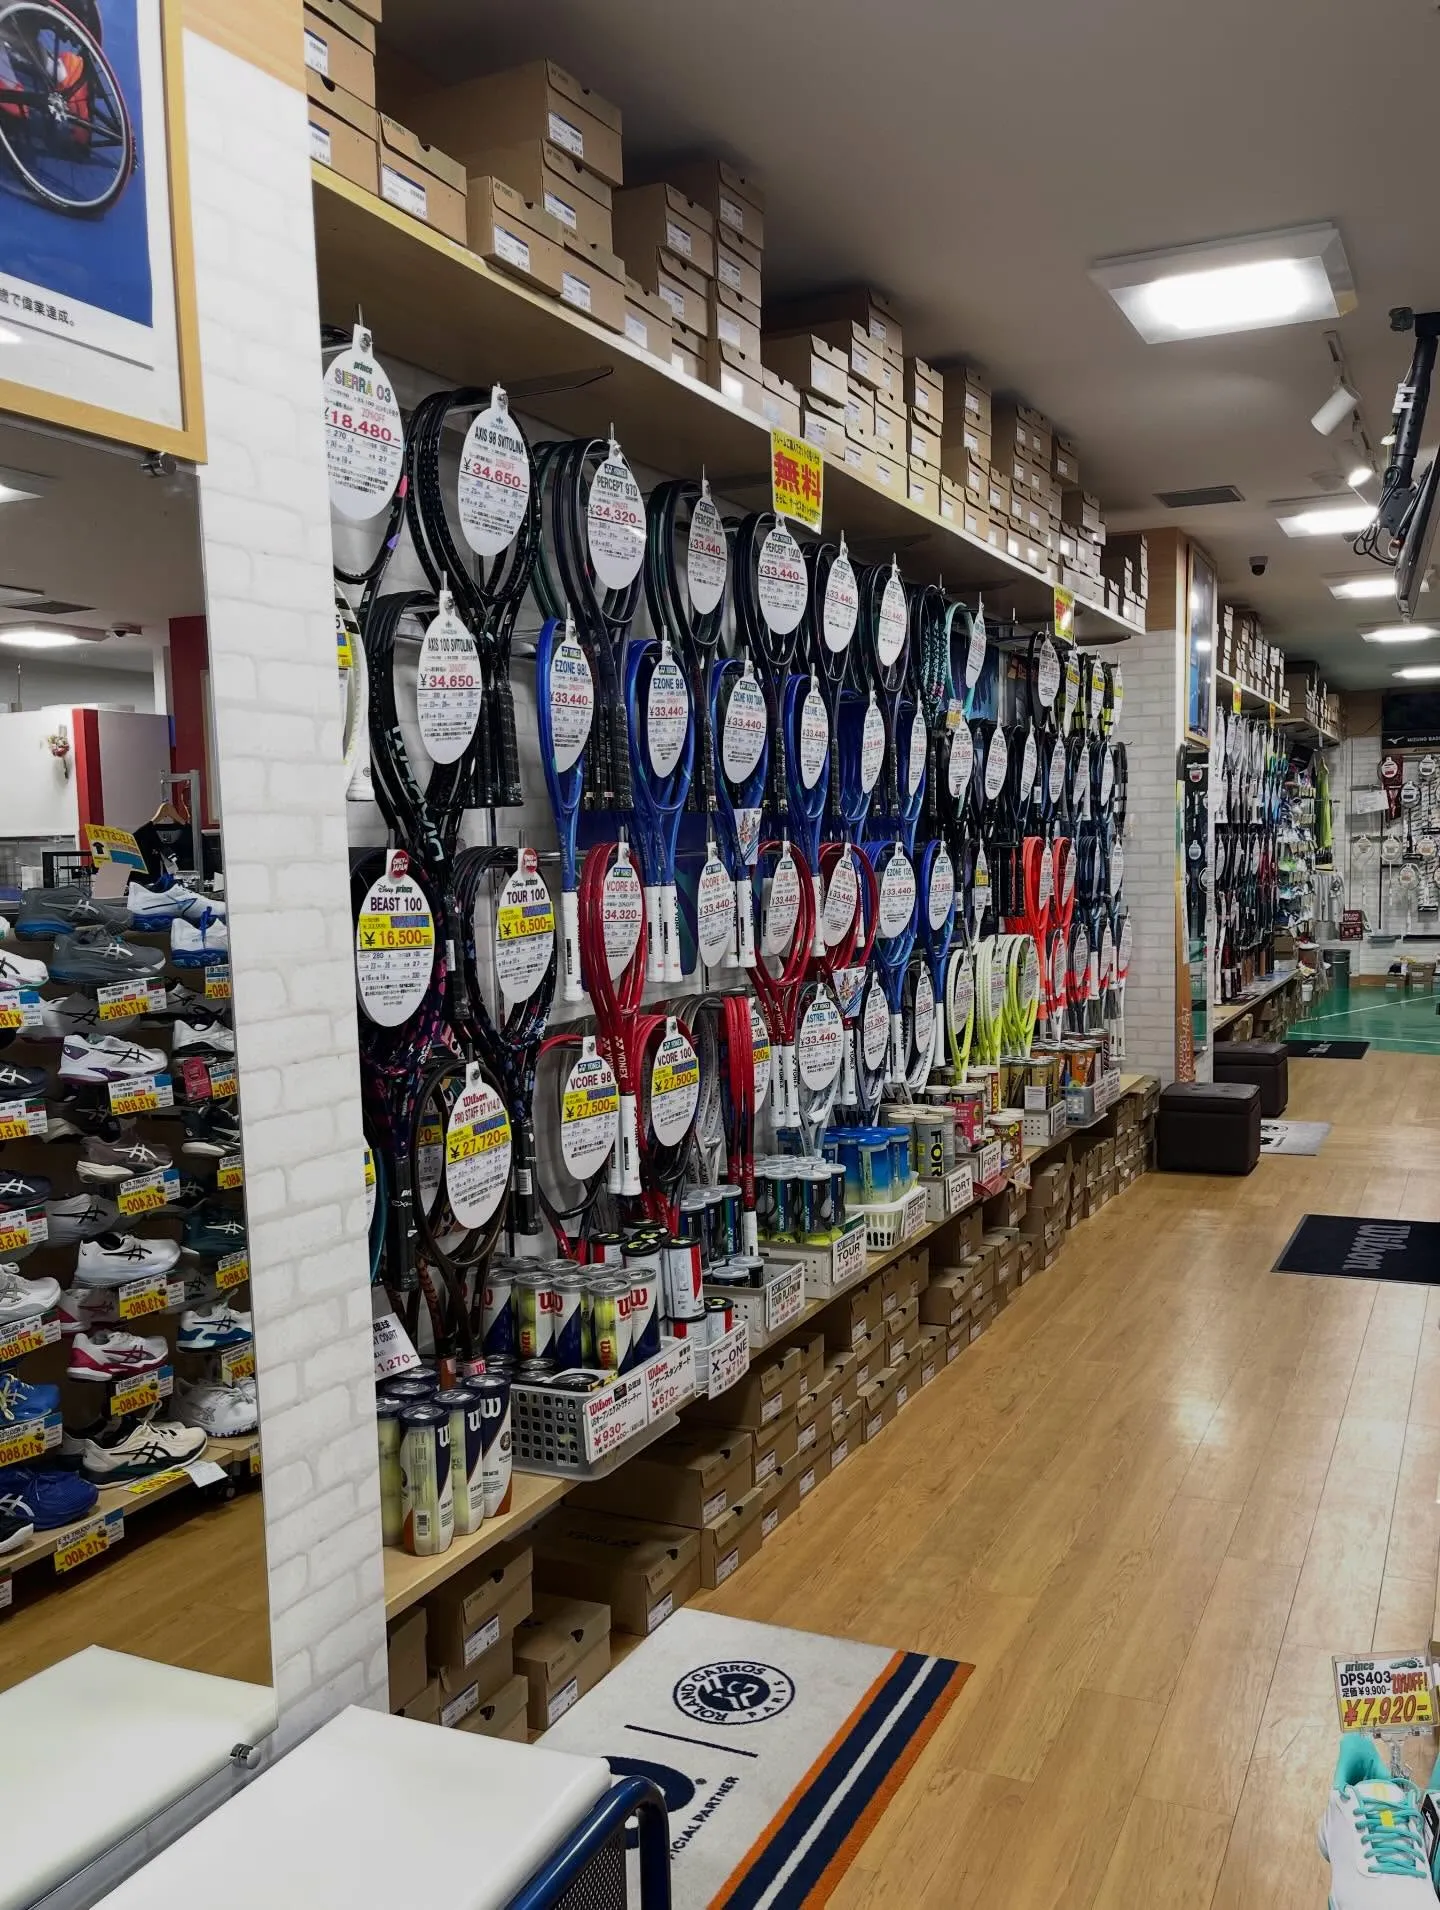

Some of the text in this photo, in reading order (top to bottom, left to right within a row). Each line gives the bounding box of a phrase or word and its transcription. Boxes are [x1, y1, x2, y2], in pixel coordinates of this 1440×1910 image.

[334, 368, 374, 397] SIERRA
[376, 384, 391, 403] 03
[475, 426, 488, 443] AXIS
[488, 431, 497, 446] 98
[596, 475, 624, 493] PERCEPT
[774, 452, 821, 508] 無料
[440, 638, 449, 651] 100
[554, 660, 575, 674] EZONE
[653, 678, 684, 690] EZONE 98
[606, 880, 640, 892] VCORE 95
[701, 876, 721, 890] VCORE
[370, 897, 423, 912] BEAST 100
[507, 888, 546, 905] TOUR 100
[806, 1011, 826, 1024] ASTREL
[617, 1052, 630, 1079] YONEX
[657, 1047, 692, 1067] VCORE 100
[570, 1071, 612, 1090] VCORE 98
[463, 1093, 488, 1107] Wilson
[454, 1111, 465, 1126] PRO
[465, 1105, 479, 1121] STAFF
[983, 1151, 1000, 1168] FORT
[951, 1178, 971, 1195] FORT
[837, 1242, 860, 1263] TOUR
[1342, 1224, 1412, 1271] Wilson
[648, 1362, 668, 1380] Wilson
[589, 1396, 613, 1417] Wilson
[594, 1422, 627, 1447] ¥930-
[1345, 1661, 1375, 1673] prince
[1340, 1671, 1392, 1686] DPS403
[680, 1664, 767, 1722] ROLAND GARROS
[749, 1680, 786, 1718] PARIS
[1344, 1695, 1428, 1727] ¥7,920-
